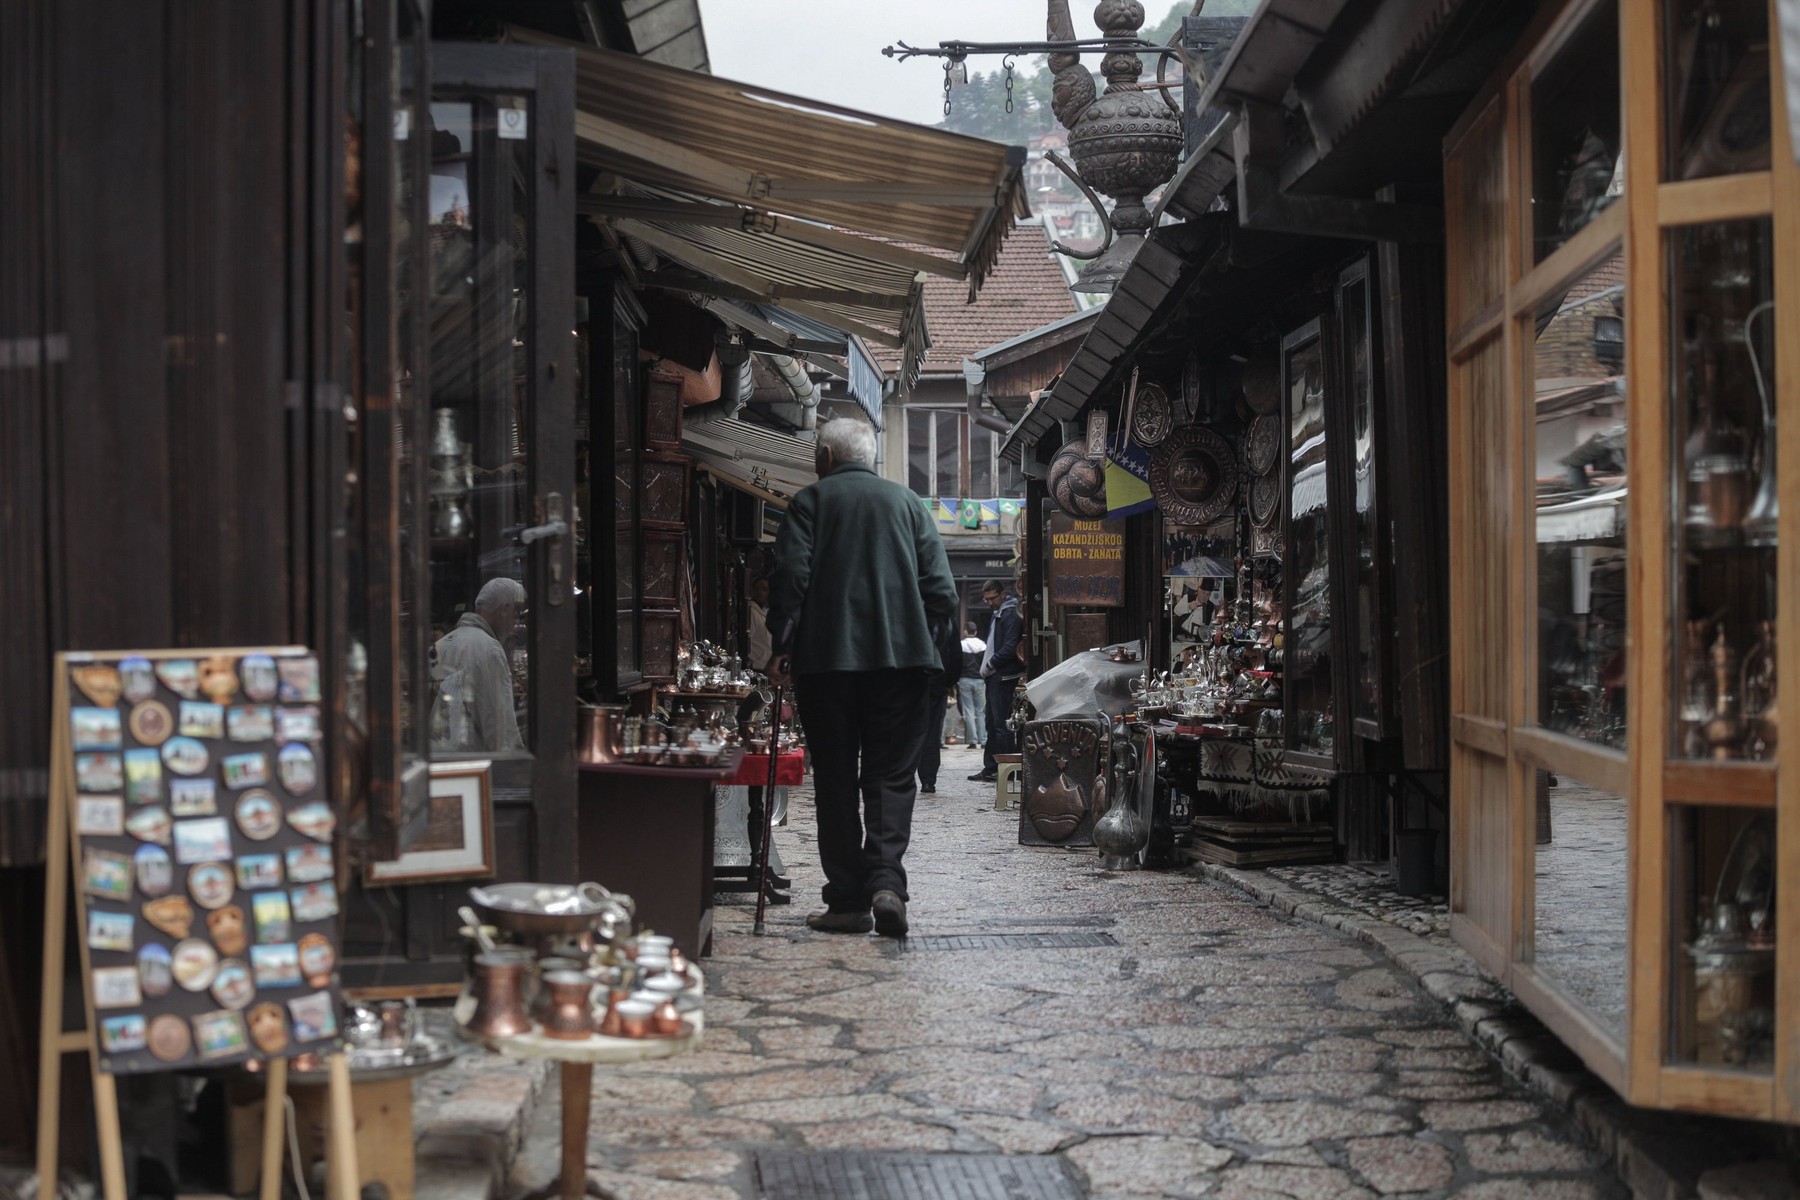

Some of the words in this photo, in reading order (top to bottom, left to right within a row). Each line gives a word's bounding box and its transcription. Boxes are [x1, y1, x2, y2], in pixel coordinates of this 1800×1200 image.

[1074, 520, 1101, 531] MUZEJ
[1054, 548, 1083, 559] OBRTA
[1089, 548, 1122, 559] ZANATA
[1024, 722, 1097, 755] SLOVENIJA
